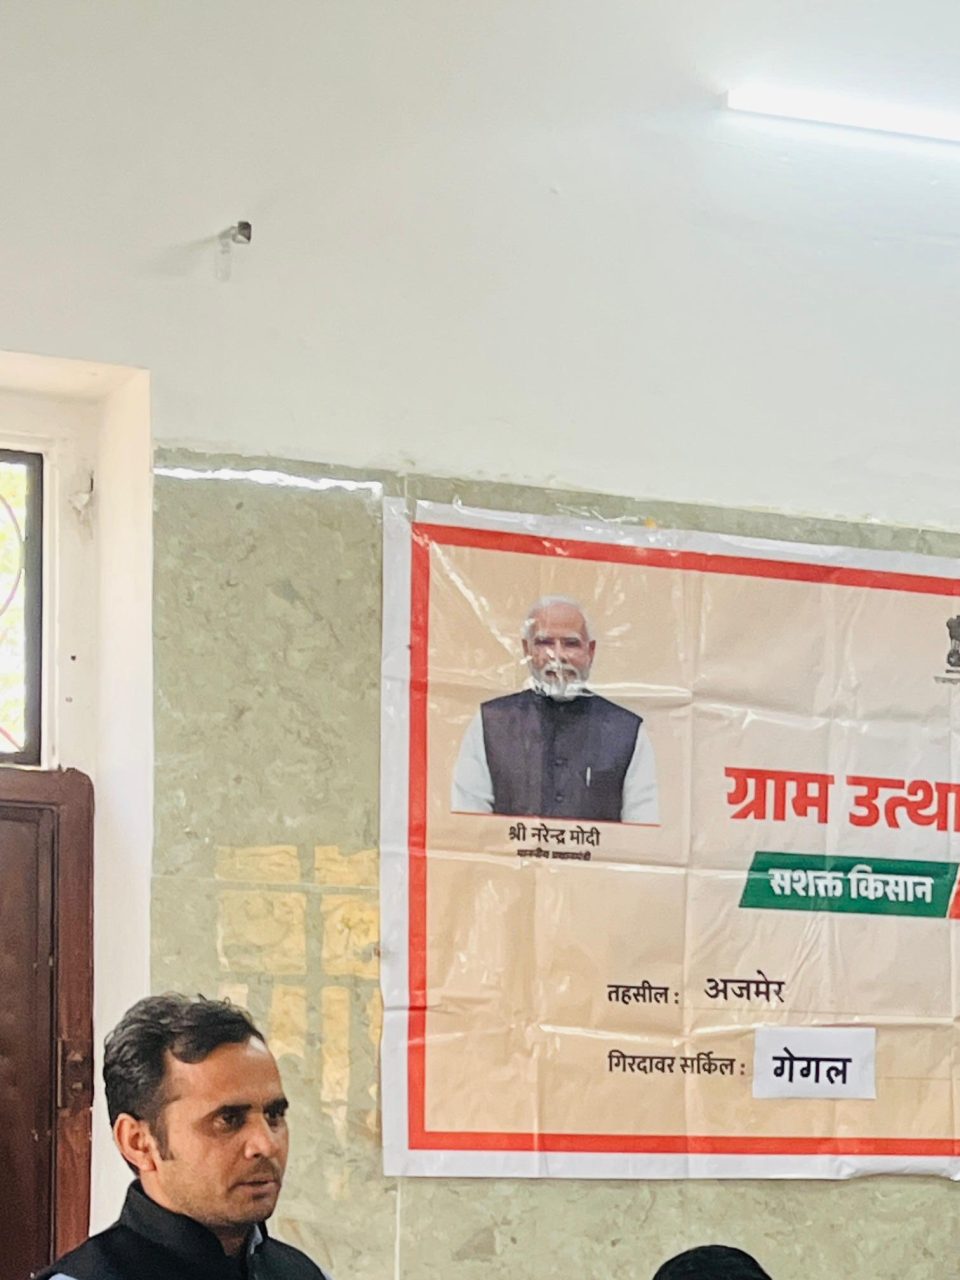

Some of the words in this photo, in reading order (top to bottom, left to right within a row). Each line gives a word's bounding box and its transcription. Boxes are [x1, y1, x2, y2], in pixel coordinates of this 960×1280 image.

[724, 767, 834, 824] ग्राम
[509, 823, 526, 841] श्री
[531, 823, 566, 844] नरेन्द्र
[570, 826, 601, 846] मोदी
[768, 867, 845, 898] सशक्त
[848, 864, 934, 904] किसान
[704, 970, 785, 1003] अजमेर
[608, 1050, 676, 1074] गिरदावर
[773, 1047, 852, 1084] गेगल
